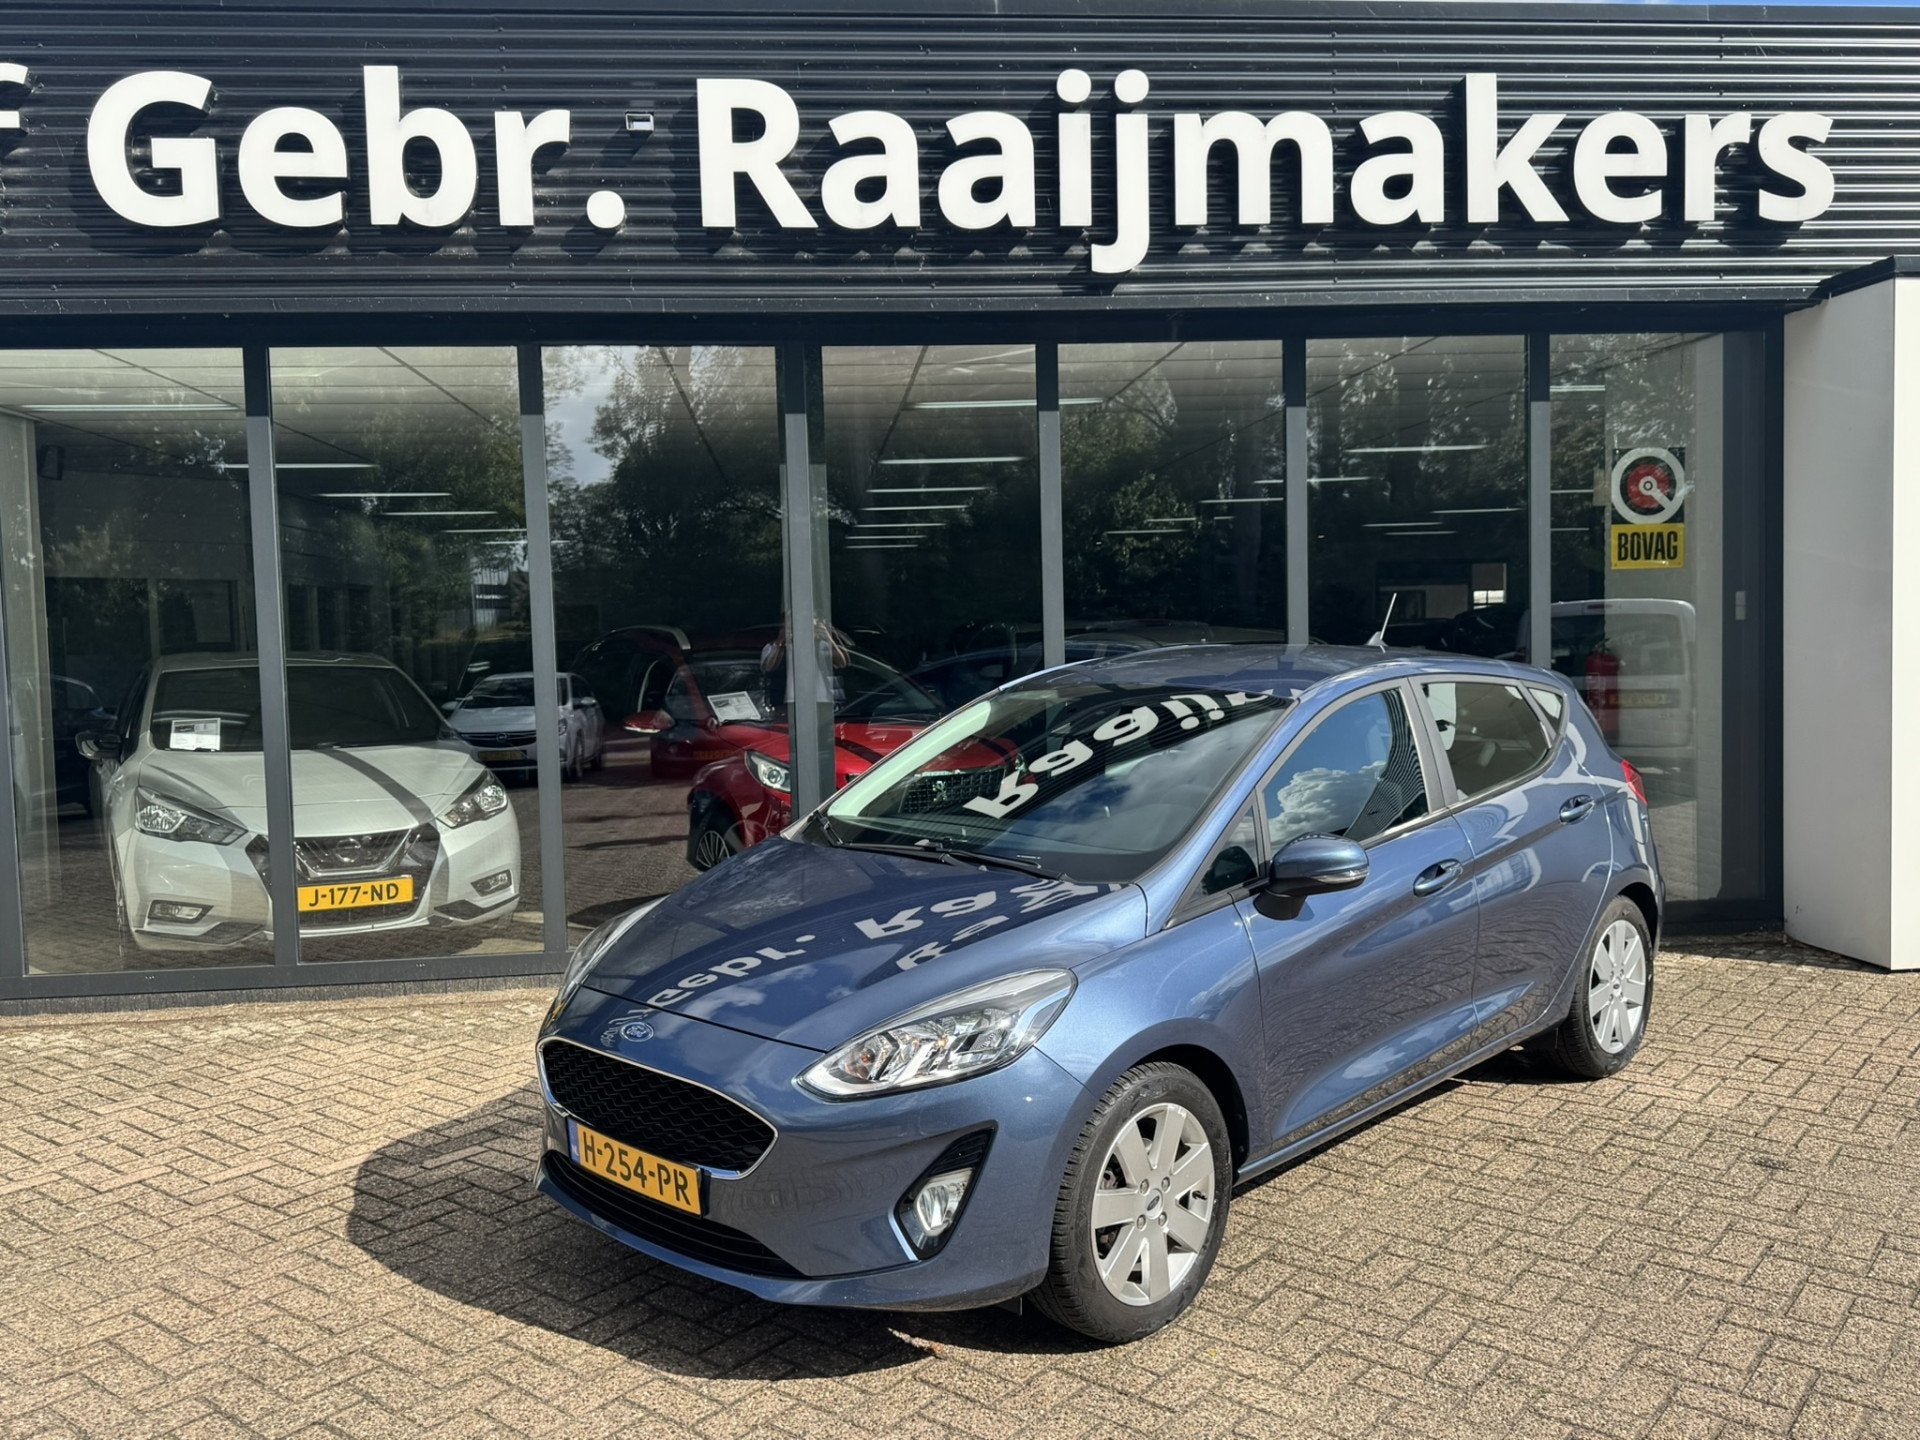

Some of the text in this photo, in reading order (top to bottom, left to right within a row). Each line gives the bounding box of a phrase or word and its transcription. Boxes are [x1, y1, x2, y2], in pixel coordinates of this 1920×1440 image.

[87, 65, 1836, 273] Gebr. Raaijmakers
[1617, 530, 1679, 562] BOVAG
[308, 882, 400, 908] J-177-ND
[582, 1130, 692, 1207] H-254-PR
